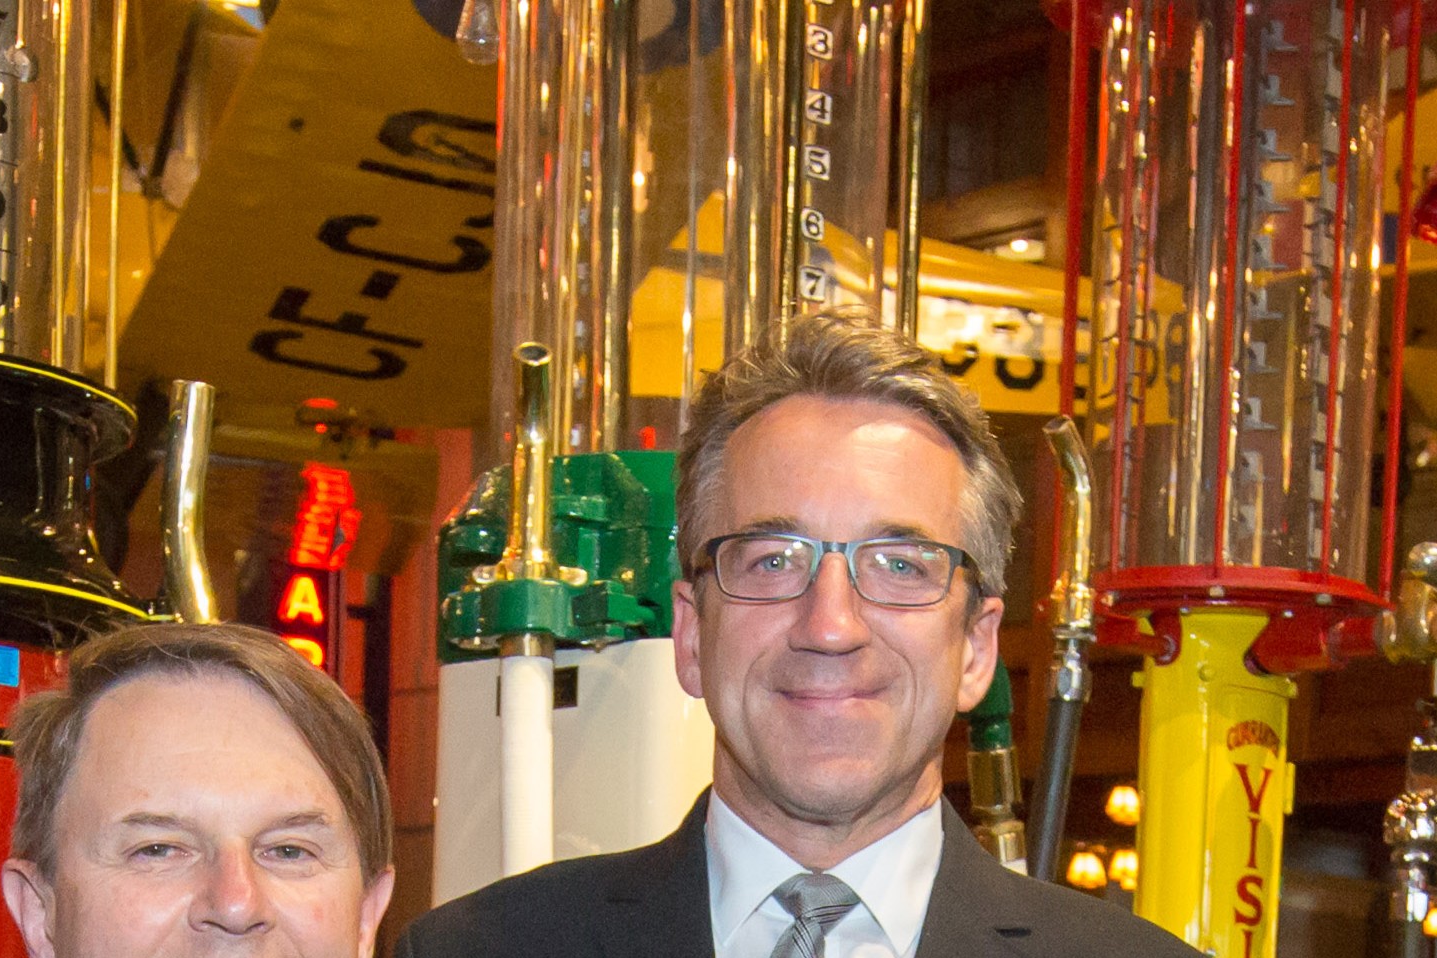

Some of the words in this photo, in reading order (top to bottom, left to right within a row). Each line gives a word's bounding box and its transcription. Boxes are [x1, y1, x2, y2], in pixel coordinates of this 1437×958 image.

[811, 30, 828, 55] 3
[808, 95, 828, 120] 4
[807, 151, 827, 177] 5
[805, 211, 821, 237] 6
[805, 271, 823, 297] 7
